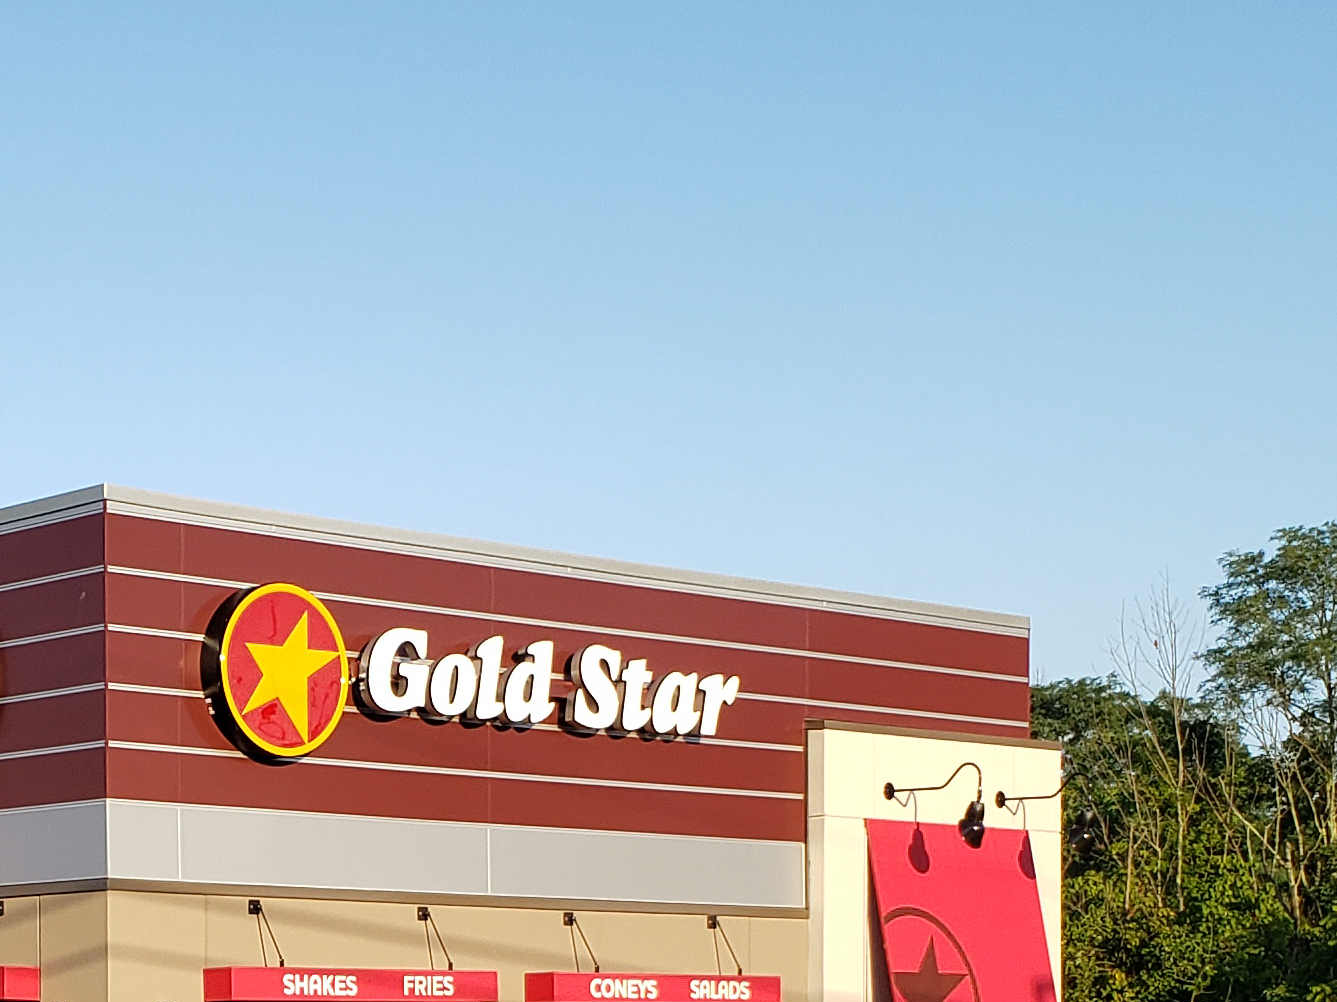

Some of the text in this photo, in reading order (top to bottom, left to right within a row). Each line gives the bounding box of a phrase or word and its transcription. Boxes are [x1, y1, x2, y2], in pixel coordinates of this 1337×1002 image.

[367, 627, 741, 737] Gold Star
[282, 973, 454, 996] SHAKES FRIES
[590, 978, 751, 1000] CONEYS SALADS
